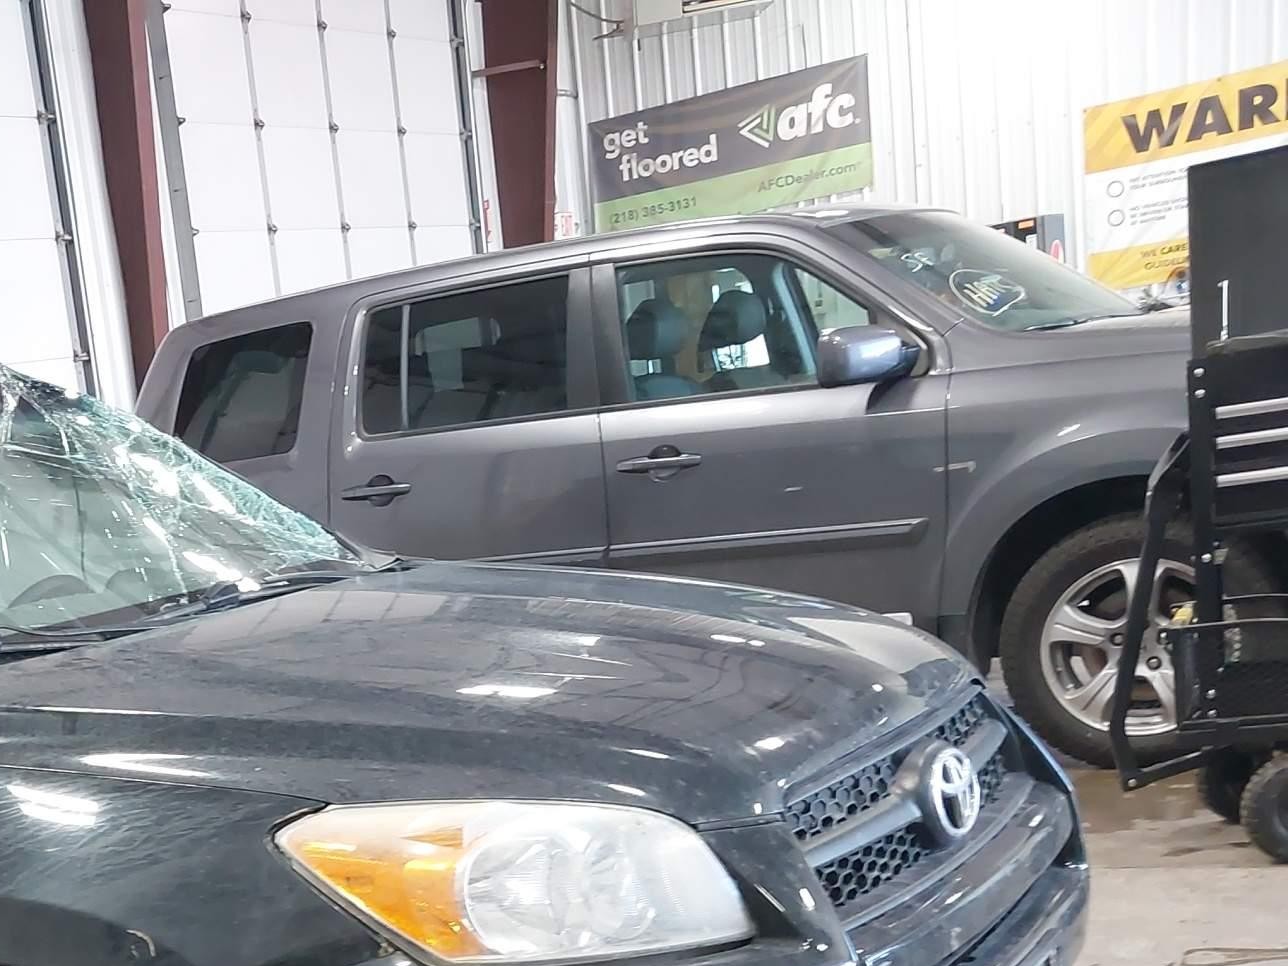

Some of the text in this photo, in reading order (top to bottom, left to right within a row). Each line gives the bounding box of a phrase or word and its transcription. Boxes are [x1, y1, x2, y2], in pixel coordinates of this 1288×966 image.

[1120, 78, 1288, 153] WAR
[603, 121, 650, 160] get
[619, 133, 718, 182] floored
[609, 196, 698, 225] (218) 385-3131
